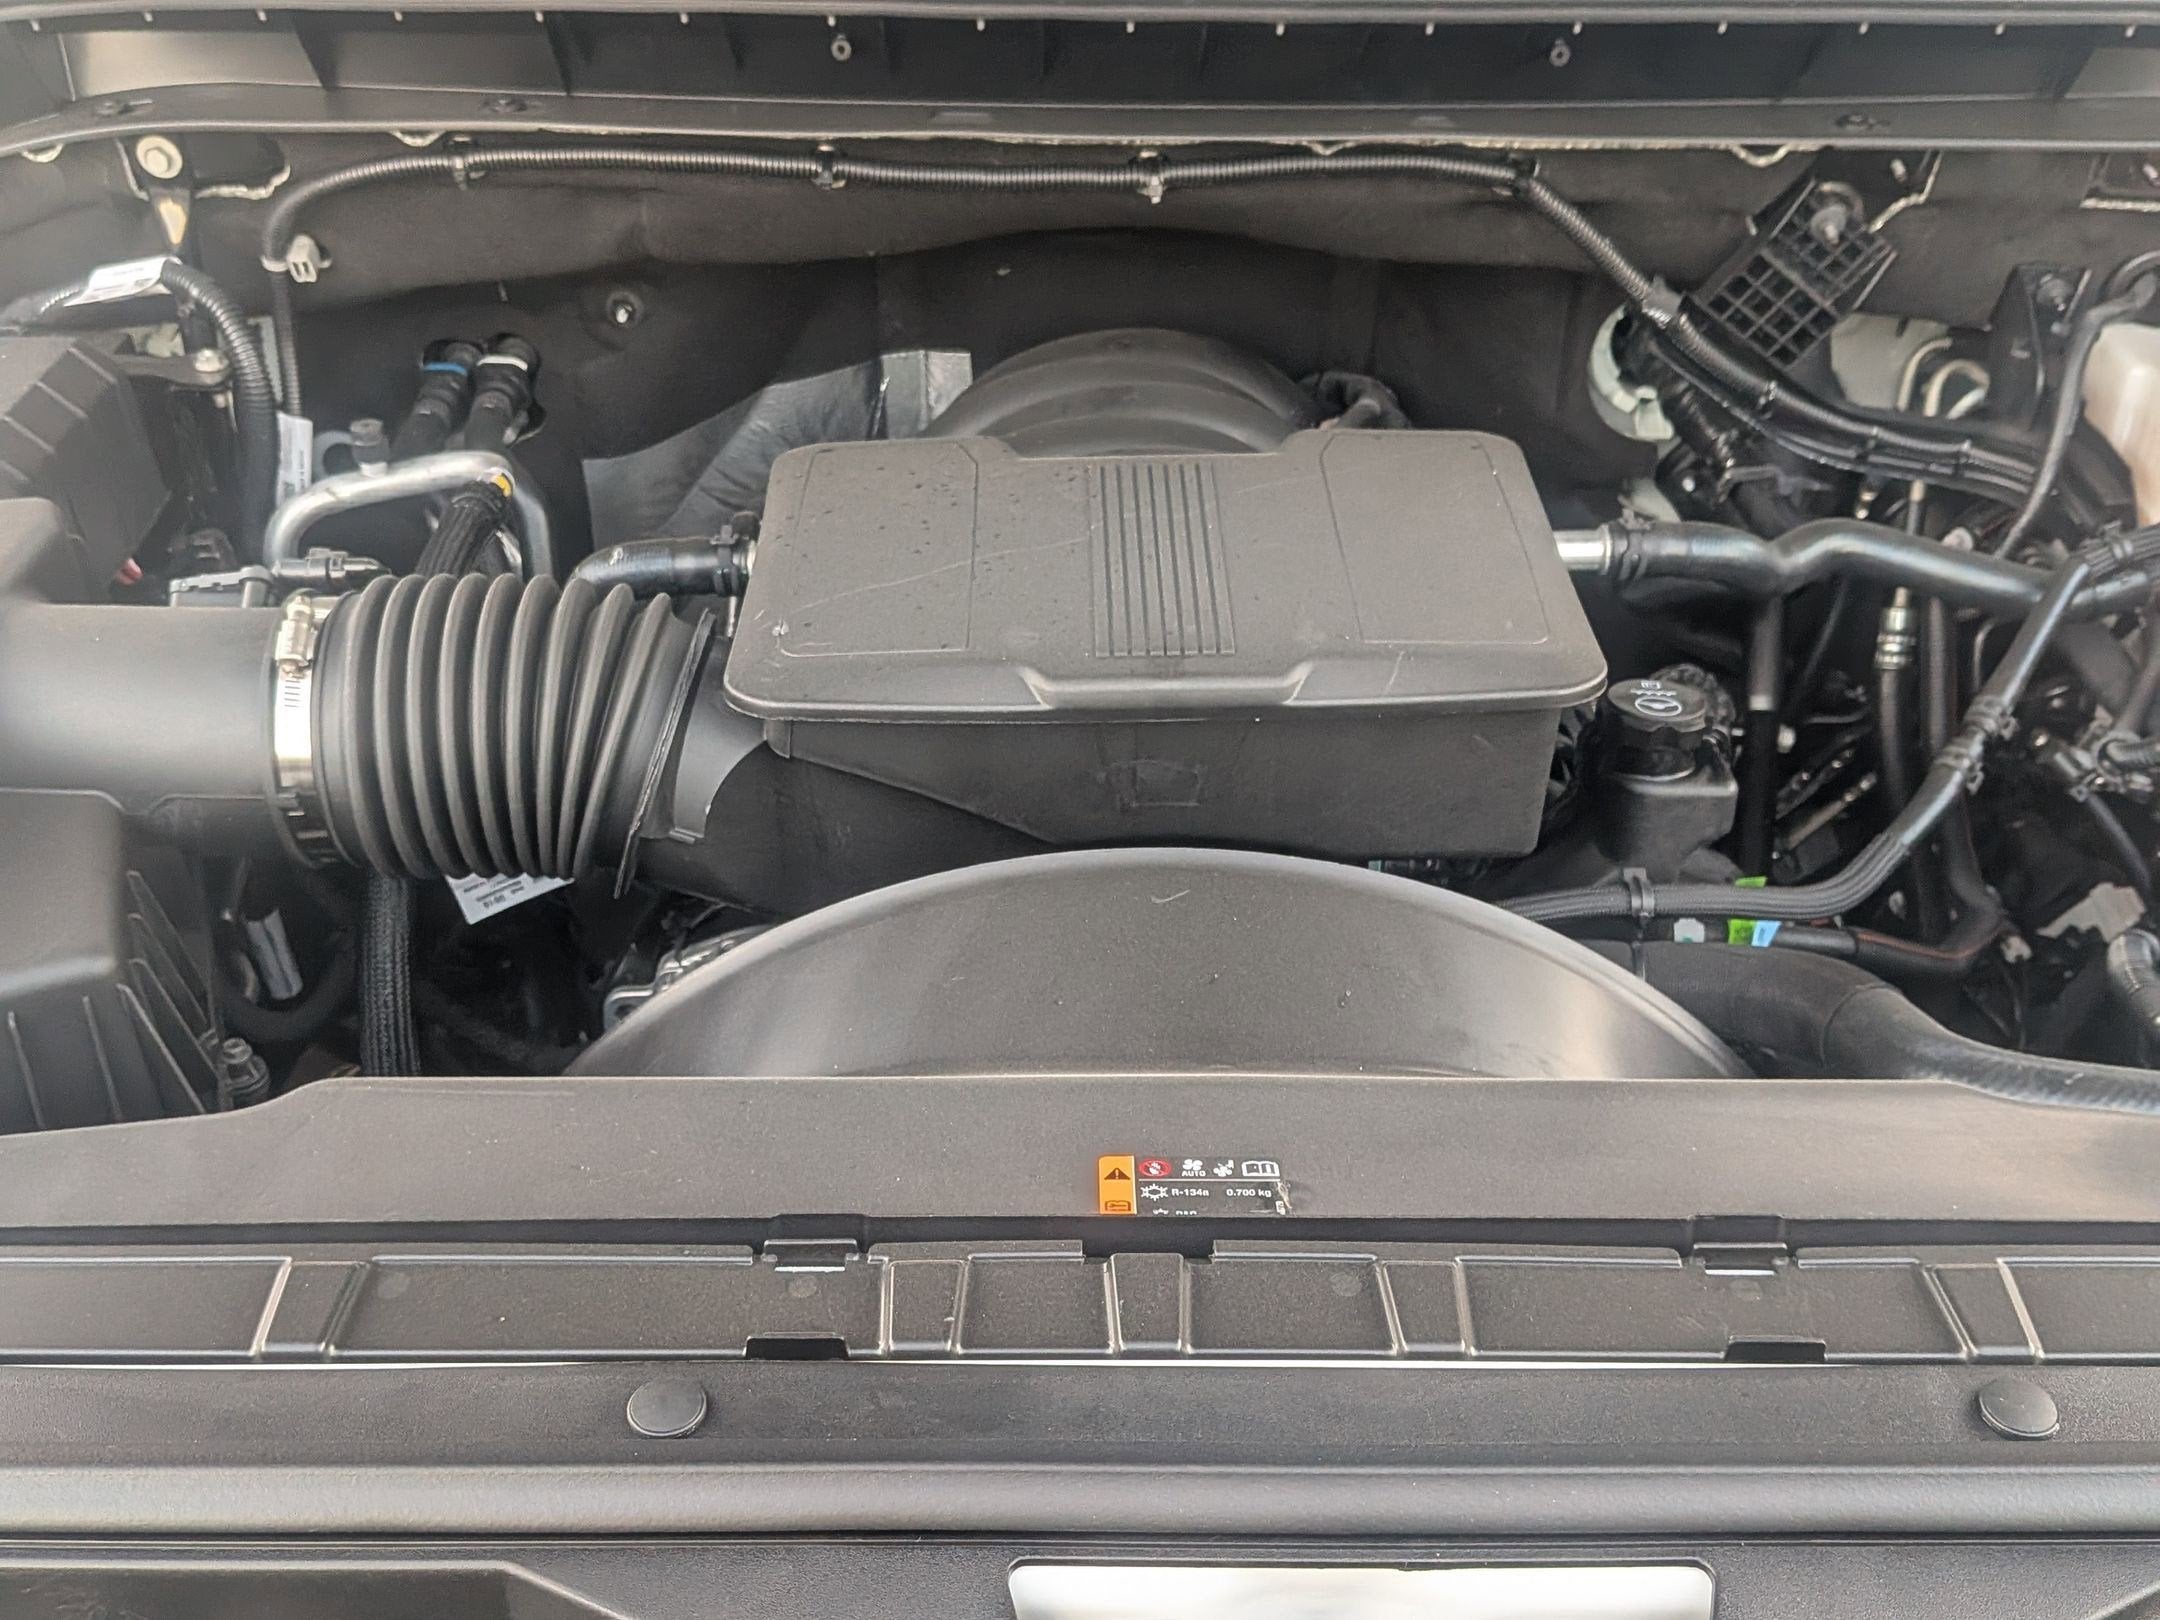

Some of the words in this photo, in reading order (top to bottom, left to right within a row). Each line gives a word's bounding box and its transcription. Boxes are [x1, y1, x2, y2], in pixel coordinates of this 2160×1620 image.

[1171, 1188, 1209, 1197] R-134a
[1226, 1188, 1256, 1197] 0.700
[1258, 1188, 1272, 1198] kg
